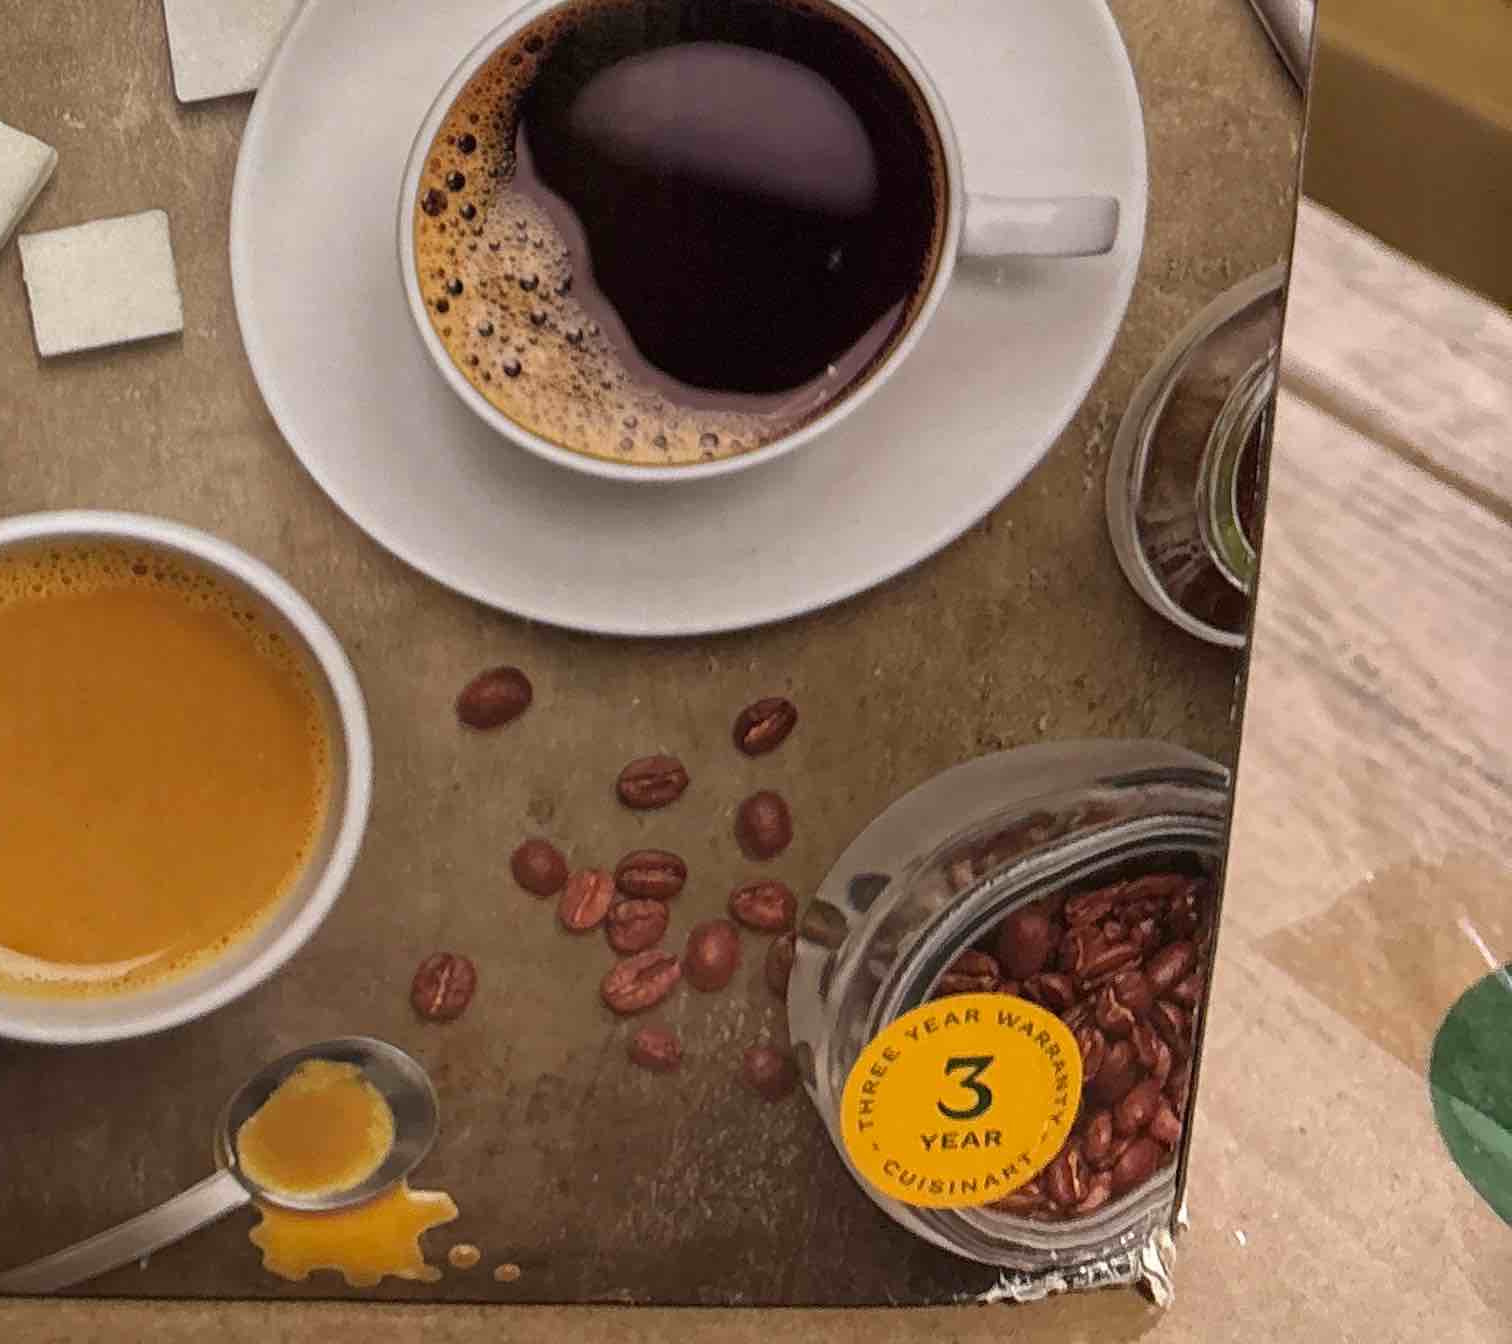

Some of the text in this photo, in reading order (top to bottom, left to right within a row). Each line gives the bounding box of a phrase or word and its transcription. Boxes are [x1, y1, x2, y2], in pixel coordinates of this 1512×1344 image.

[858, 1009, 1070, 1132] THREE YEAR WARRANTY
[936, 1055, 995, 1121] 3
[920, 1129, 1002, 1152] YEAR
[882, 1150, 1033, 1195] CUISINART
